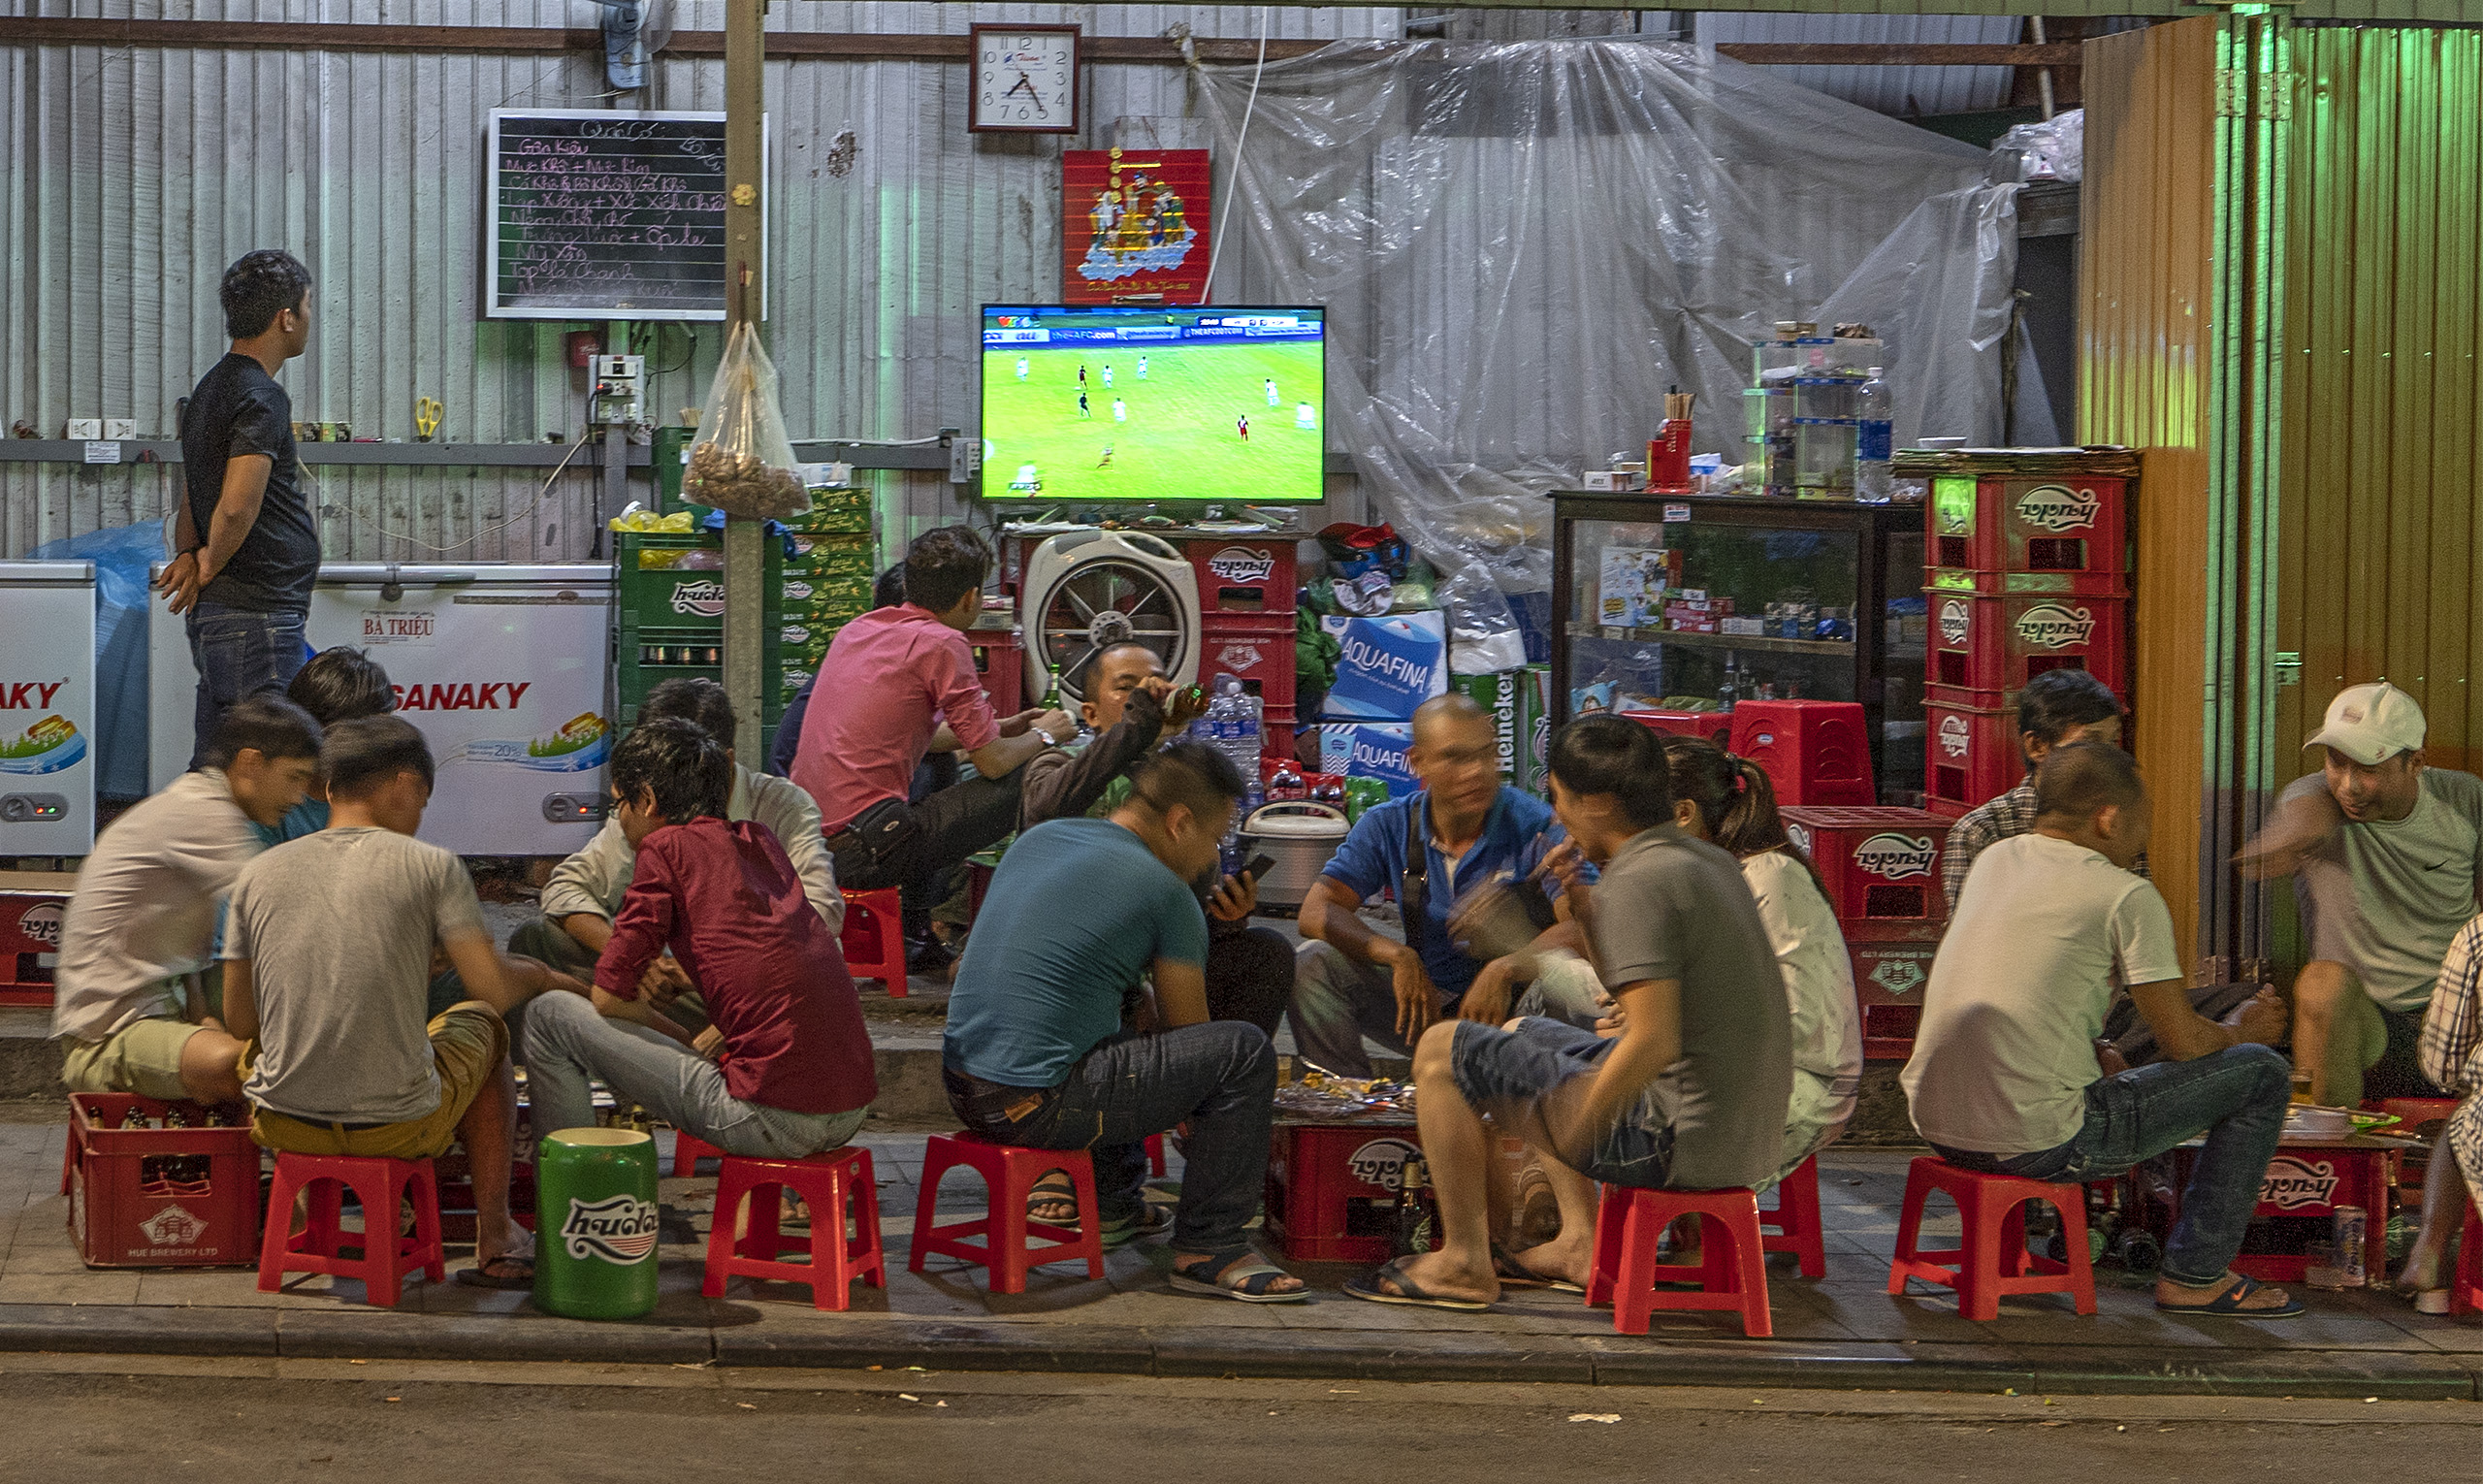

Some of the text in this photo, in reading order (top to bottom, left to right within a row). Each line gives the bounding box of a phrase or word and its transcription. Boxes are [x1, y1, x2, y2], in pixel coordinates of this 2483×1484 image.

[1018, 37, 1033, 50] 12
[1055, 50, 1067, 65] 2
[984, 71, 1067, 85] 9 3
[983, 91, 994, 106] 8
[1054, 92, 1066, 107] 4
[999, 104, 1010, 118] 7
[1018, 106, 1029, 119] 6
[363, 614, 435, 638] BÀ TRIỆU
[1340, 635, 1429, 694] AQUAFINA
[390, 682, 532, 712] SANAKY
[1351, 740, 1420, 777] AQUAFIN
[564, 1196, 659, 1244] huda
[128, 1246, 218, 1257] HUE BREWERY LTD
